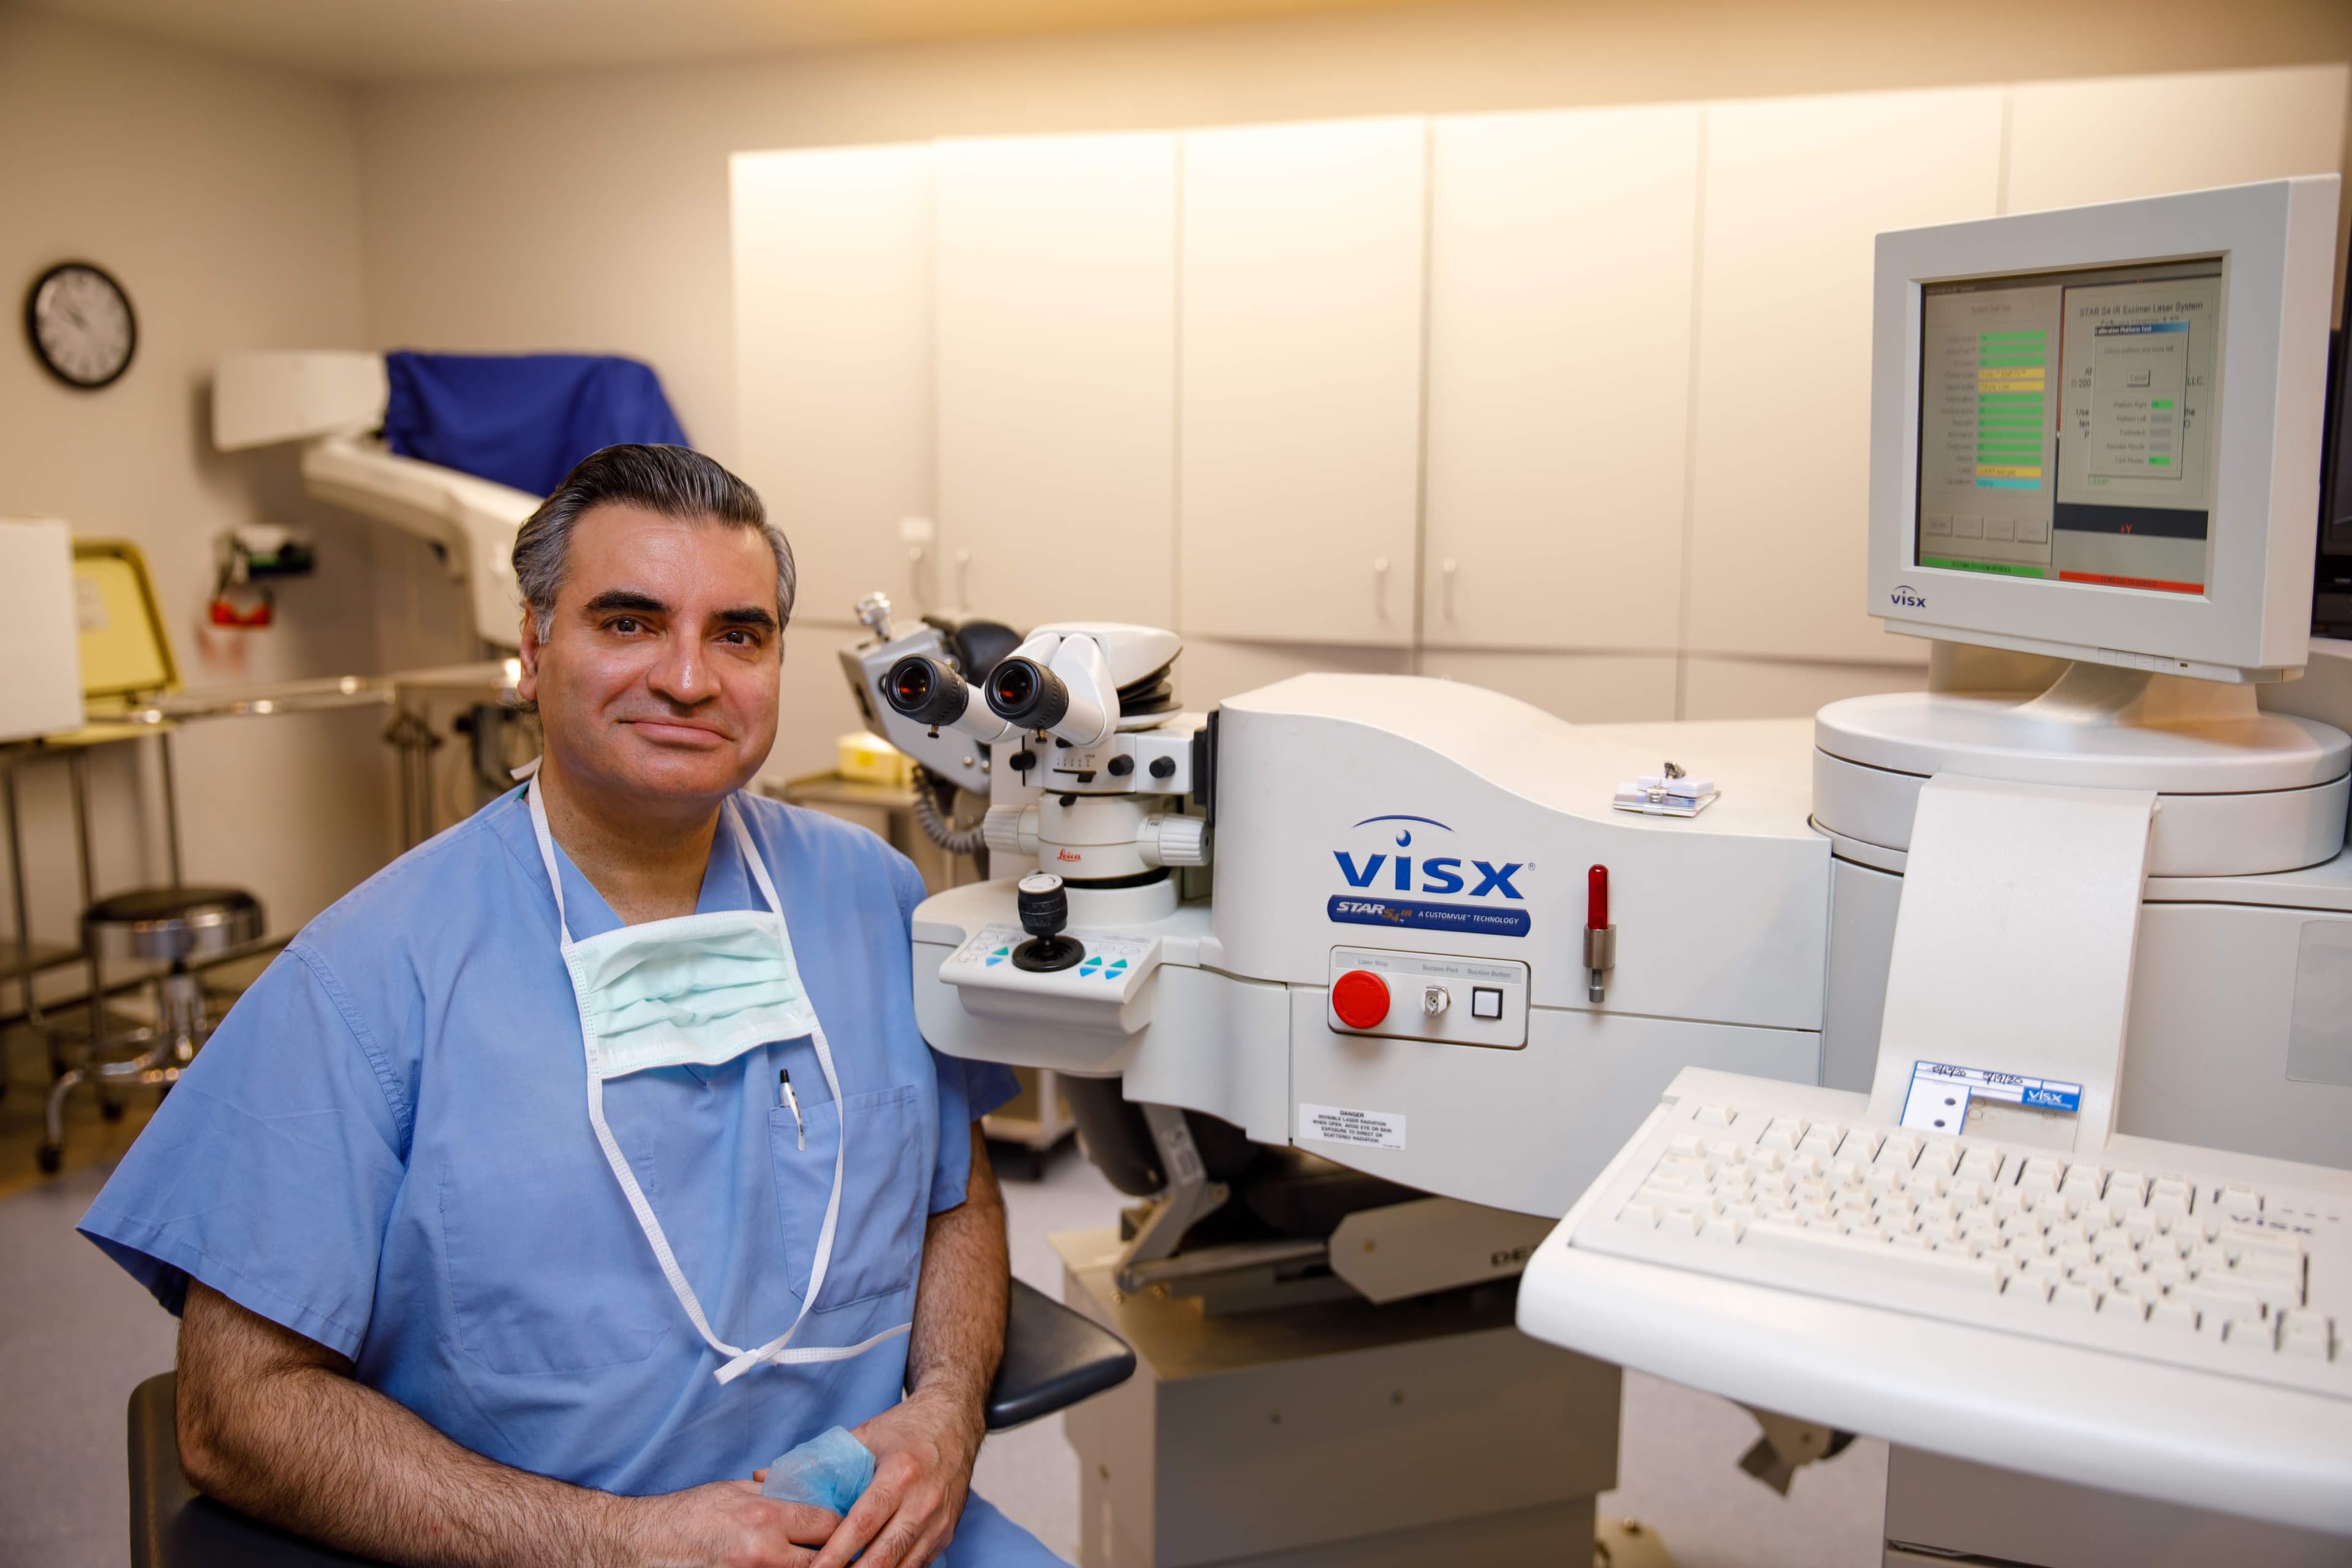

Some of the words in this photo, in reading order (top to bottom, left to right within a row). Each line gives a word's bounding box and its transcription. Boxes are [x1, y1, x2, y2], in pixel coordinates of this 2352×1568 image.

[2080, 307, 2099, 317] STAR
[2101, 307, 2111, 315] S4
[2113, 306, 2120, 315] IR
[2123, 305, 2150, 314] Excimer
[2153, 303, 2173, 312] Laser
[2175, 301, 2203, 313] System
[2079, 378, 2092, 388] 200
[1058, 849, 1081, 862] Leica
[1336, 902, 1385, 915] STAR
[1473, 915, 1519, 924] TECHNOLOGY
